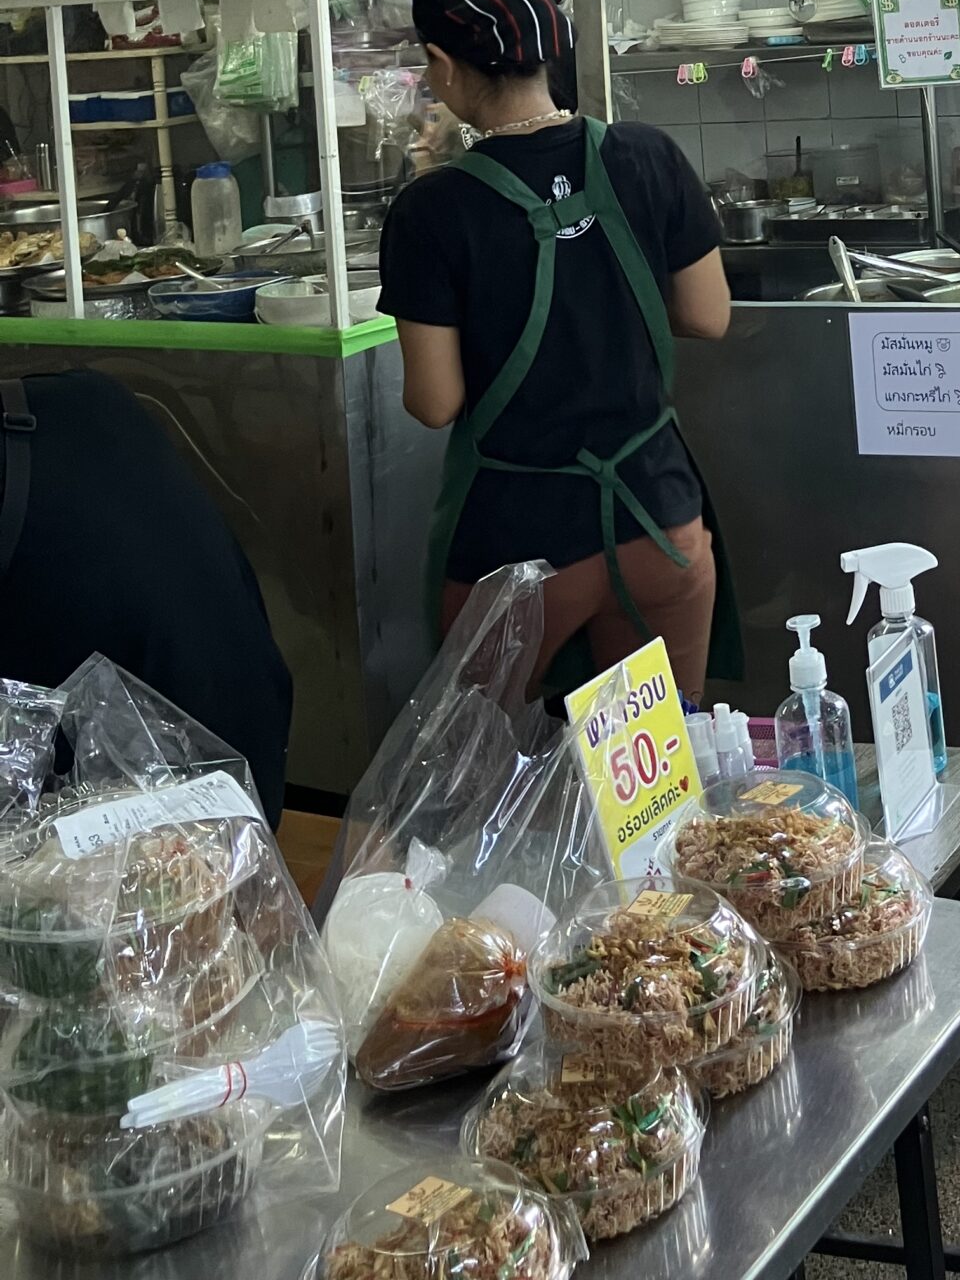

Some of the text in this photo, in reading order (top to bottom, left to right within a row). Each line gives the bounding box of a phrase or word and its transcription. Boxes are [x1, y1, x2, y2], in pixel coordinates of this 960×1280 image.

[881, 333, 933, 354] มัสมั่นหมู
[883, 359, 931, 376] มัสมั่นไก่
[887, 419, 936, 437] หมี่กรอบ
[611, 732, 678, 802] 50.-
